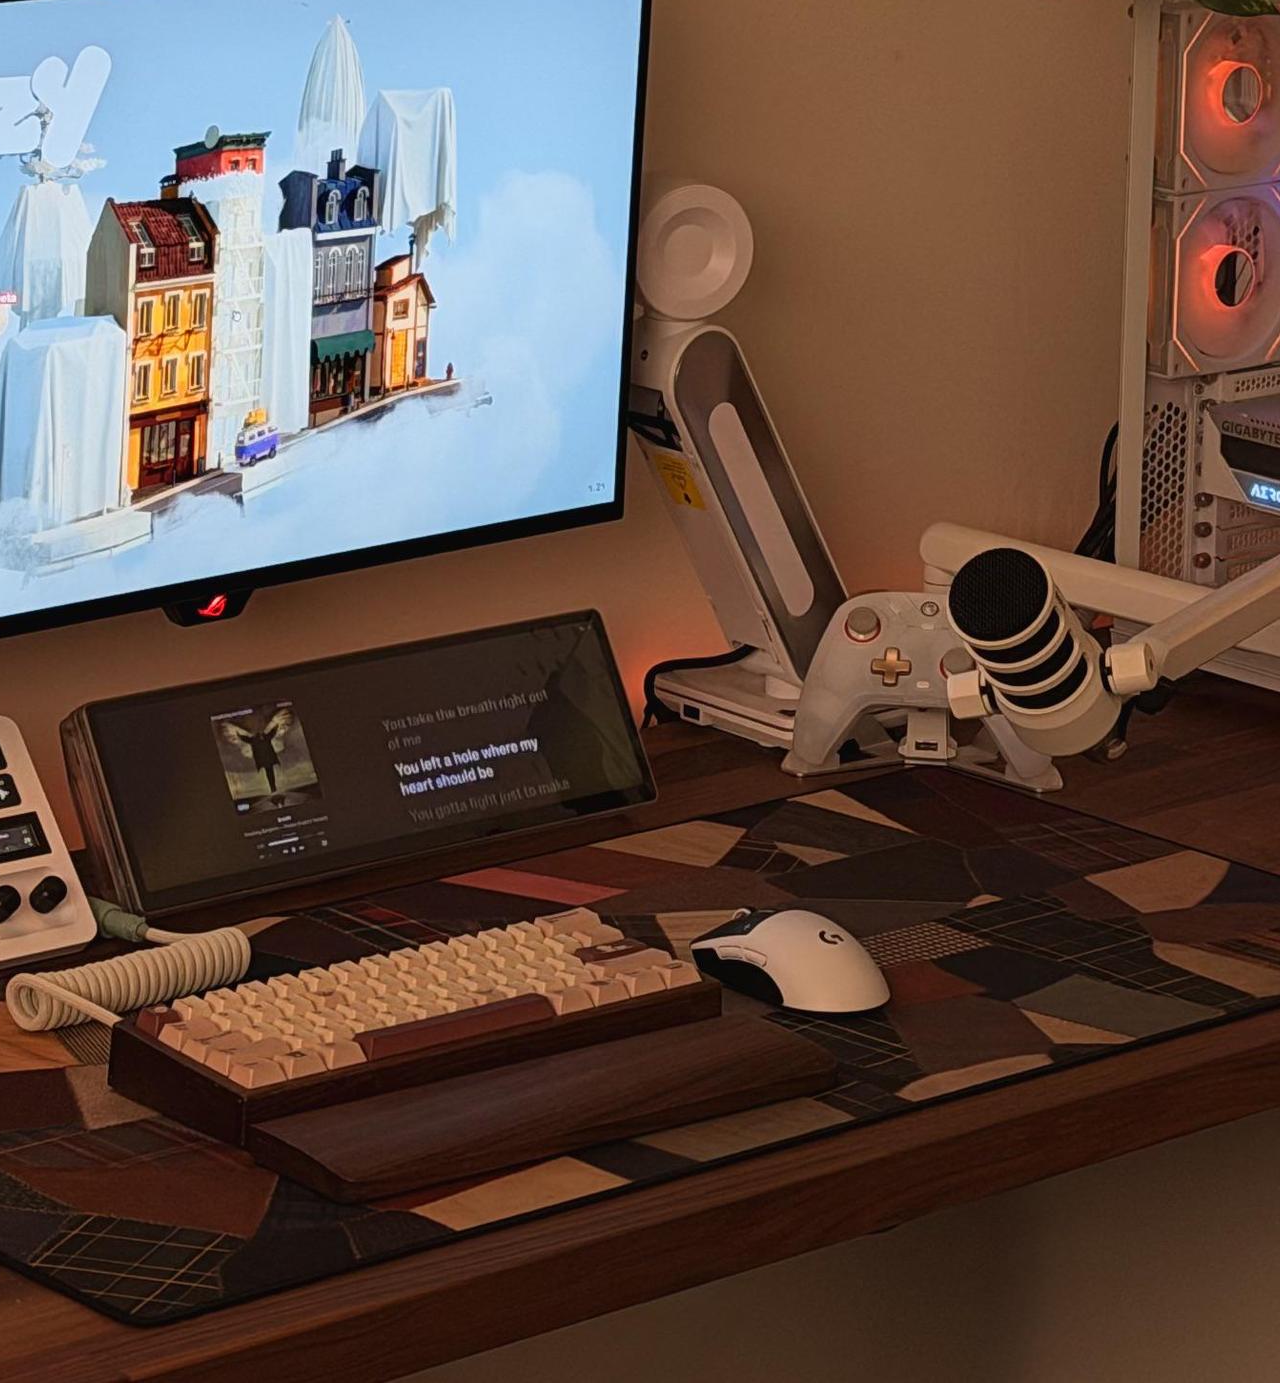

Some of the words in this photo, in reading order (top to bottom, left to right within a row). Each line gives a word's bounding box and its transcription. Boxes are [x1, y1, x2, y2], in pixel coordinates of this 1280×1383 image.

[1222, 421, 1280, 444] GIGABYTE
[382, 718, 405, 732] You
[408, 714, 433, 727] take
[436, 709, 455, 721] the
[457, 698, 497, 716] breath
[388, 738, 400, 751] of
[403, 736, 421, 746] me
[394, 763, 419, 776] You
[420, 758, 441, 770] left
[444, 756, 452, 766] a
[453, 749, 479, 764] hole
[481, 741, 518, 759] where
[520, 738, 538, 752] my
[400, 778, 434, 796] heart
[436, 768, 477, 788] should
[477, 766, 494, 778] be
[409, 809, 433, 823] You
[539, 779, 570, 794] make
